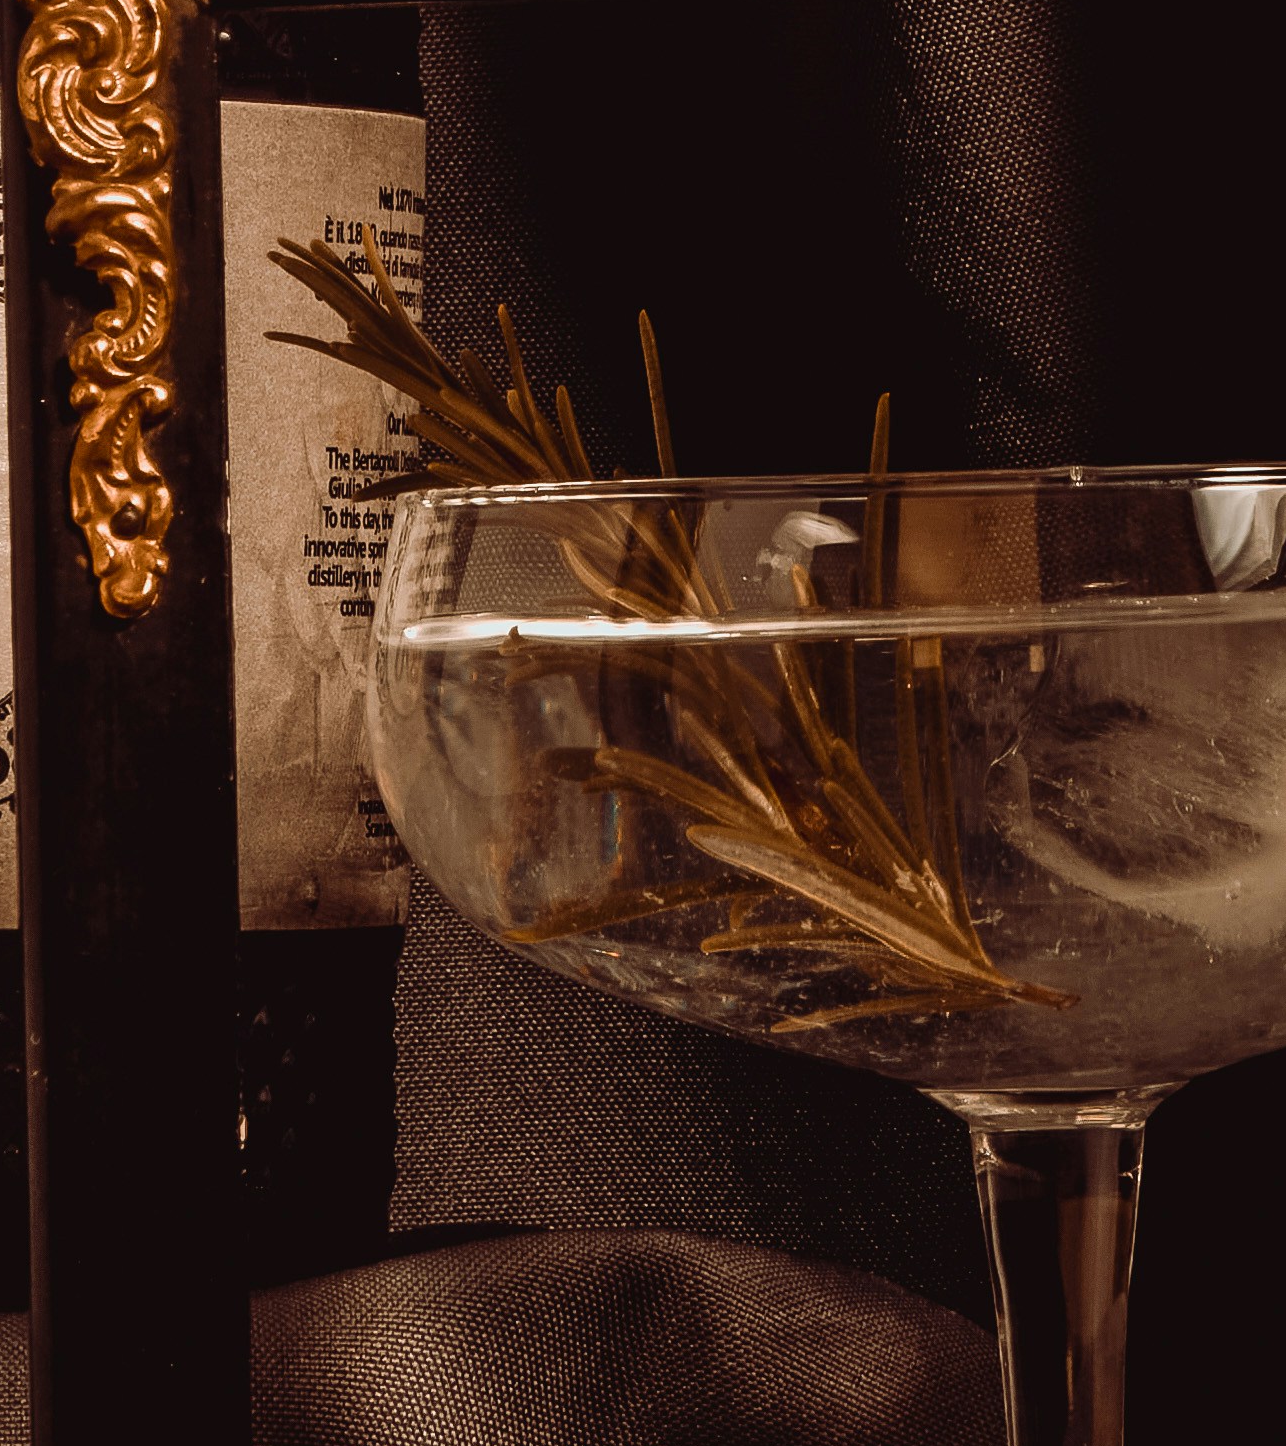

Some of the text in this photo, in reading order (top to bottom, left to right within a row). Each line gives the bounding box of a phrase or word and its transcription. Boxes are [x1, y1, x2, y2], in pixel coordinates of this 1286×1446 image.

[325, 213, 334, 244] È
[336, 220, 345, 244] il
[347, 221, 379, 249] 180,
[326, 447, 351, 471] The
[322, 505, 339, 530] To
[340, 505, 361, 530] this
[362, 506, 381, 536] day,
[303, 534, 367, 559] innovative
[308, 564, 360, 594] distillery
[361, 565, 372, 588] in
